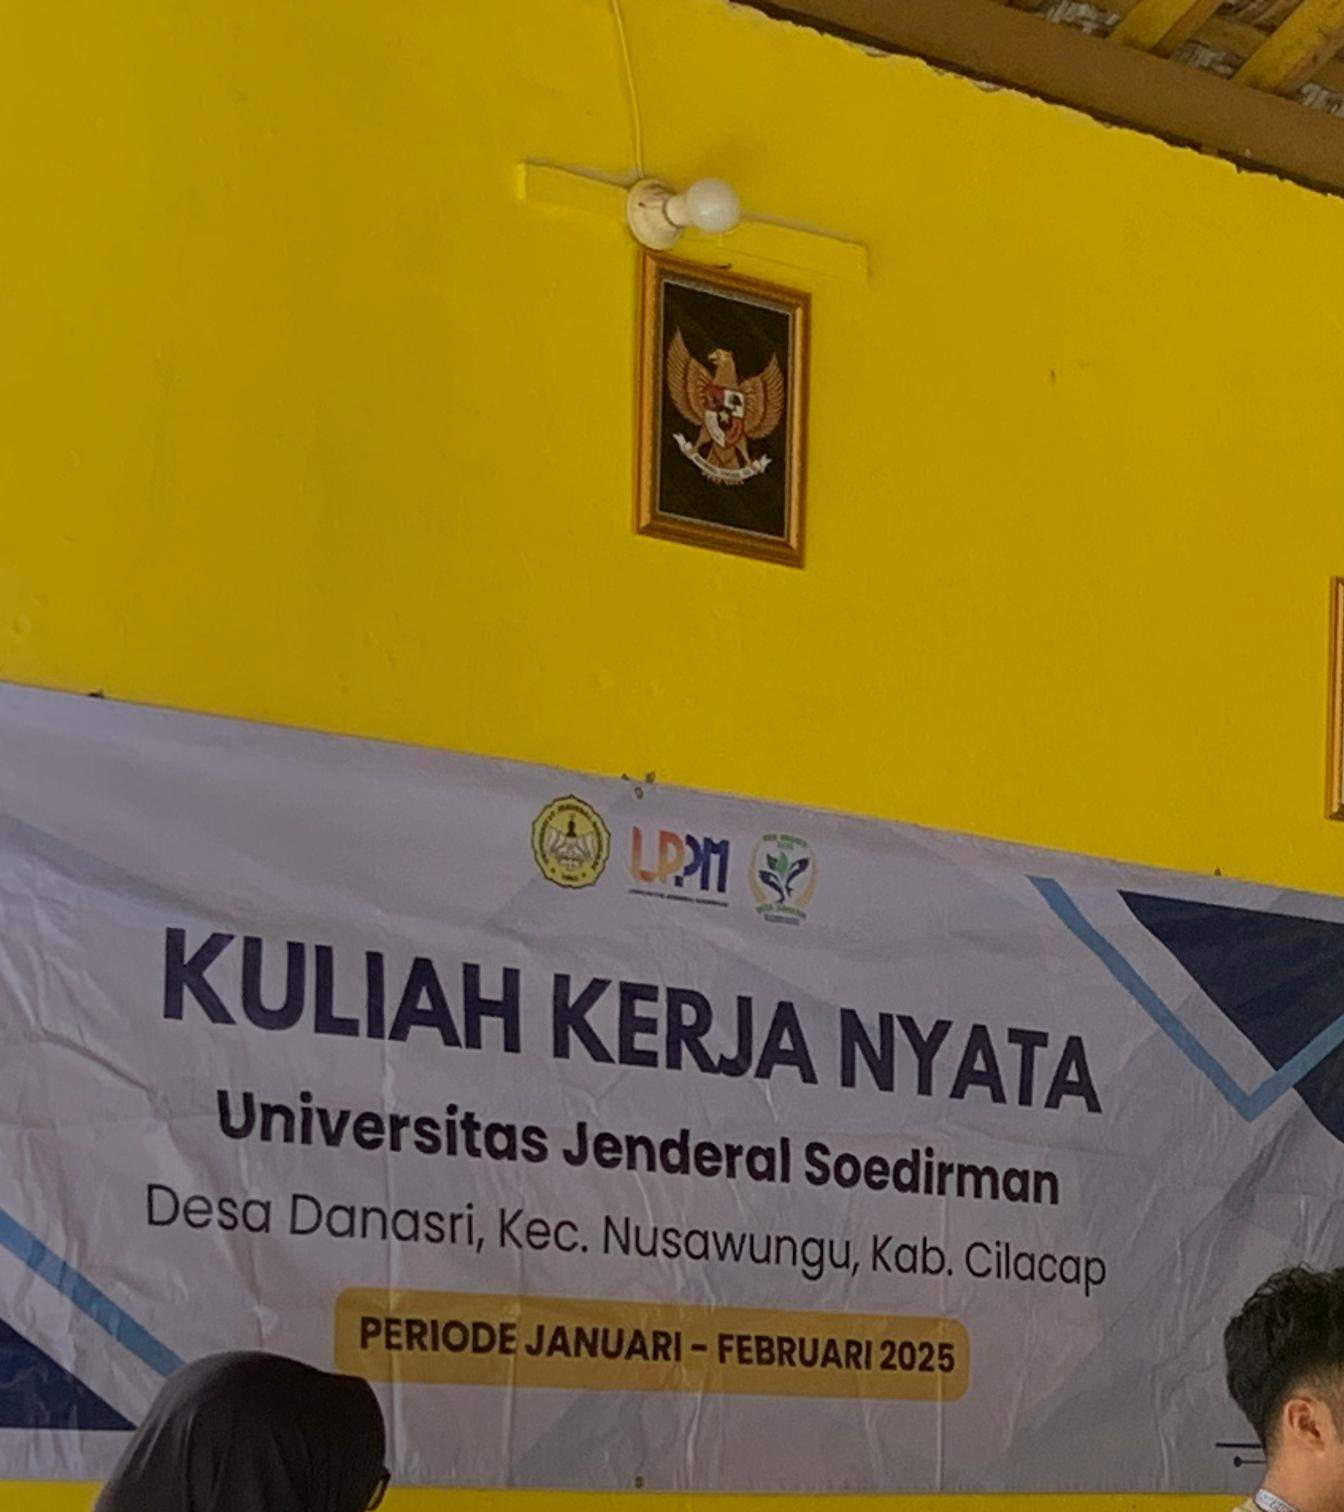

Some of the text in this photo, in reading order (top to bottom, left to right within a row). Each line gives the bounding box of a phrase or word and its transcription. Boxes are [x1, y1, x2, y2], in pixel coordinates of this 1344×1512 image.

[163, 927, 1103, 1114] KULIAH KERJA NYATA
[218, 1089, 1059, 1204] Universitas Jenderal Soedirman
[147, 1184, 1107, 1297] Desa Danasri, Kec. Nusawungu, Kab. Cilacap
[360, 1316, 516, 1355] PERIODE
[525, 1322, 682, 1363] JANUARI
[717, 1333, 873, 1370] FEBRUARI
[880, 1341, 956, 1373] 2025
